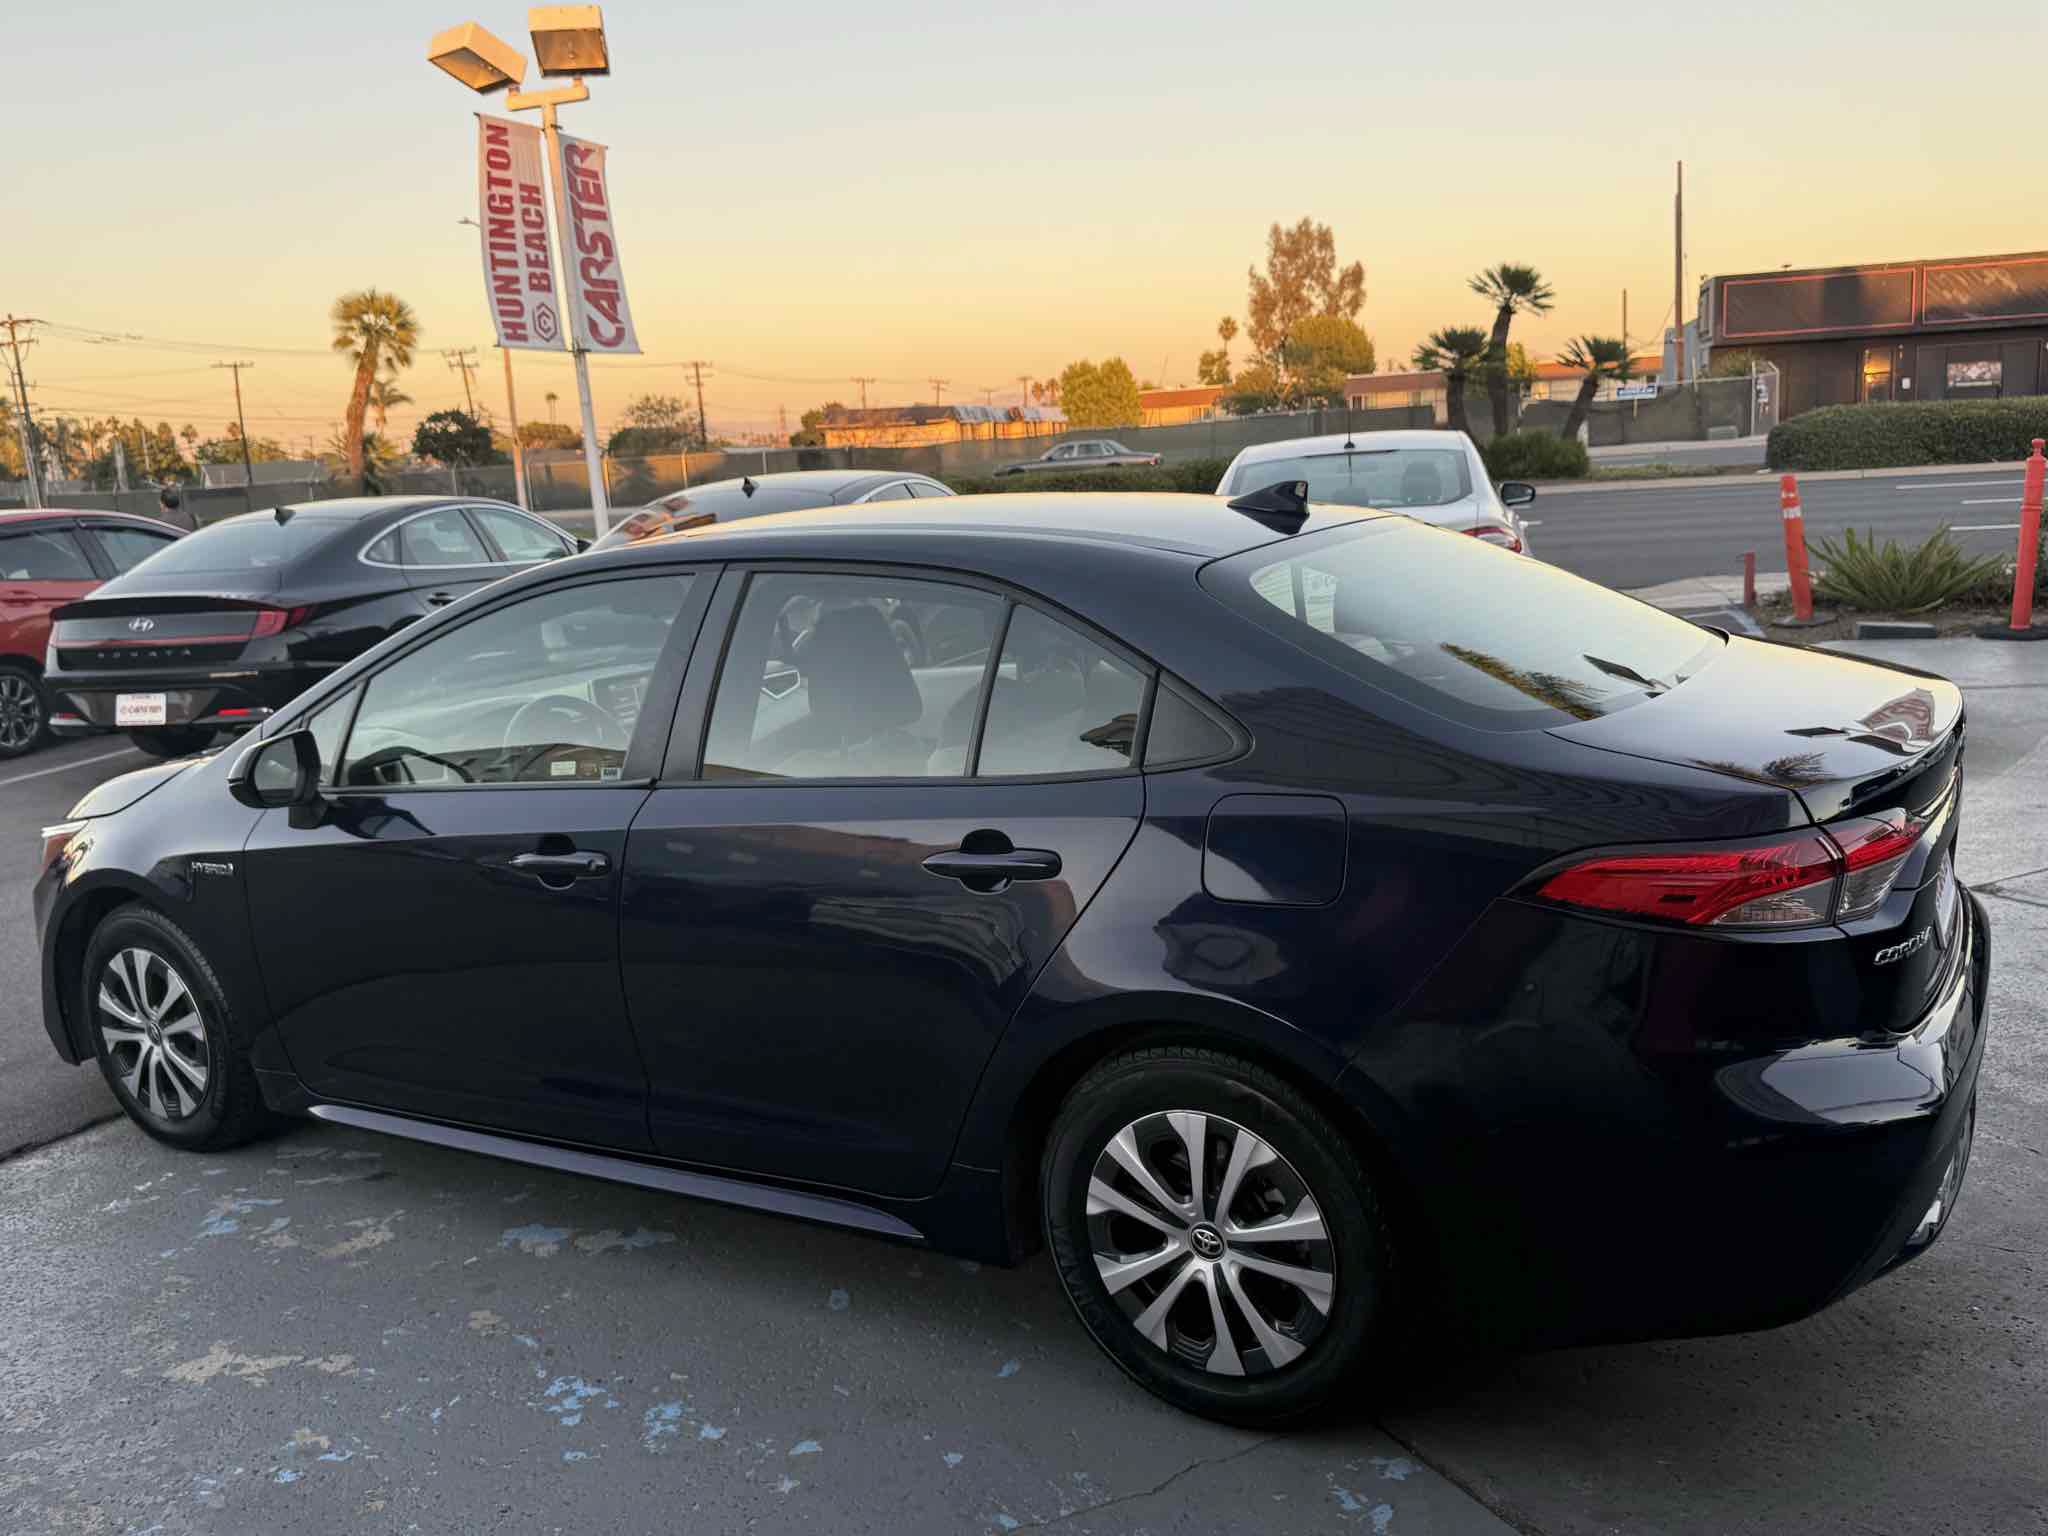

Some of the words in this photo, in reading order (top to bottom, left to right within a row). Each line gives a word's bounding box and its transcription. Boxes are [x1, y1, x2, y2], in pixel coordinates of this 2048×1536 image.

[486, 123, 529, 342] HUNTINGTON
[519, 183, 553, 293] BEACH
[564, 143, 626, 348] CARSTER
